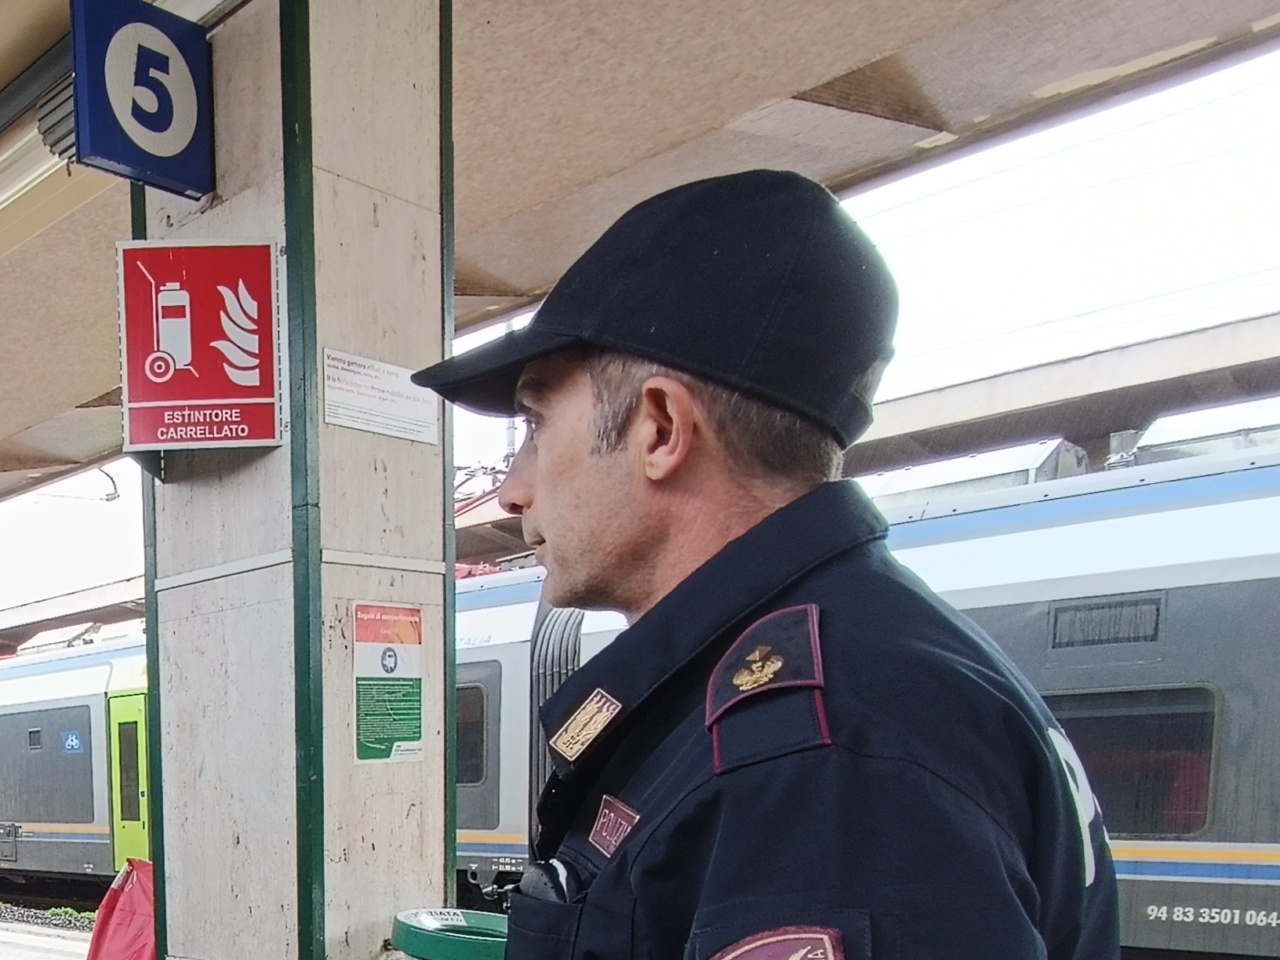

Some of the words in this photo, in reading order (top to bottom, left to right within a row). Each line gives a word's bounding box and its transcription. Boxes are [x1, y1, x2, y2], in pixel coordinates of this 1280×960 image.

[131, 43, 174, 133] 5
[164, 409, 241, 423] ESTINTORE
[157, 424, 249, 440] CARRELLATO
[1146, 905, 1168, 921] 94
[1172, 906, 1195, 922] 83
[1198, 907, 1241, 924] 3501
